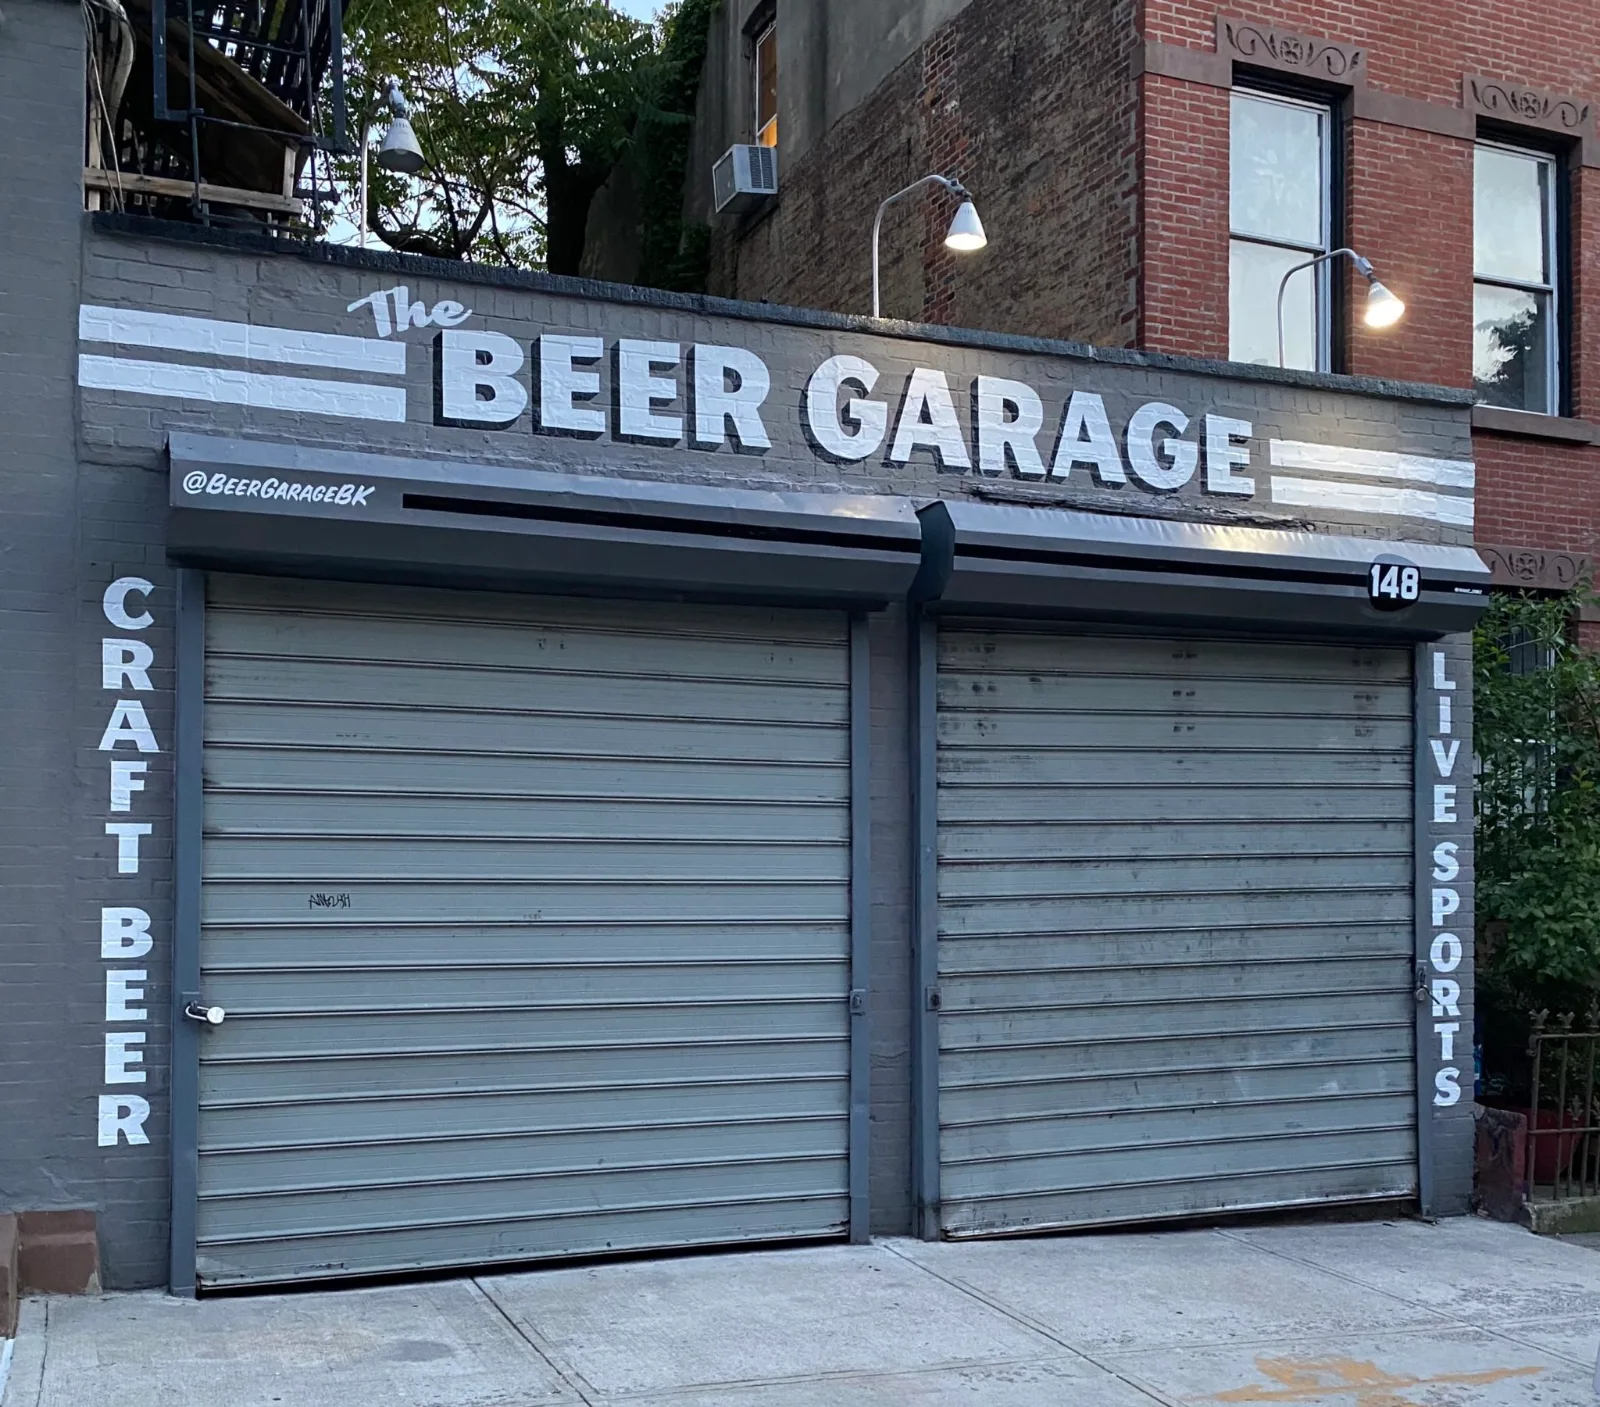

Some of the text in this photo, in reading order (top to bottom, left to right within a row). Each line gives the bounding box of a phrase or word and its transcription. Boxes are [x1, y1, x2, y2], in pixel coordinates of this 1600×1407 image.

[347, 285, 473, 337] The
[433, 328, 1256, 499] BEER GARAGE
[1370, 564, 1420, 600] 148
[97, 576, 160, 1148] CRAFT BEER
[1429, 651, 1463, 1107] LIVE SPORTS
